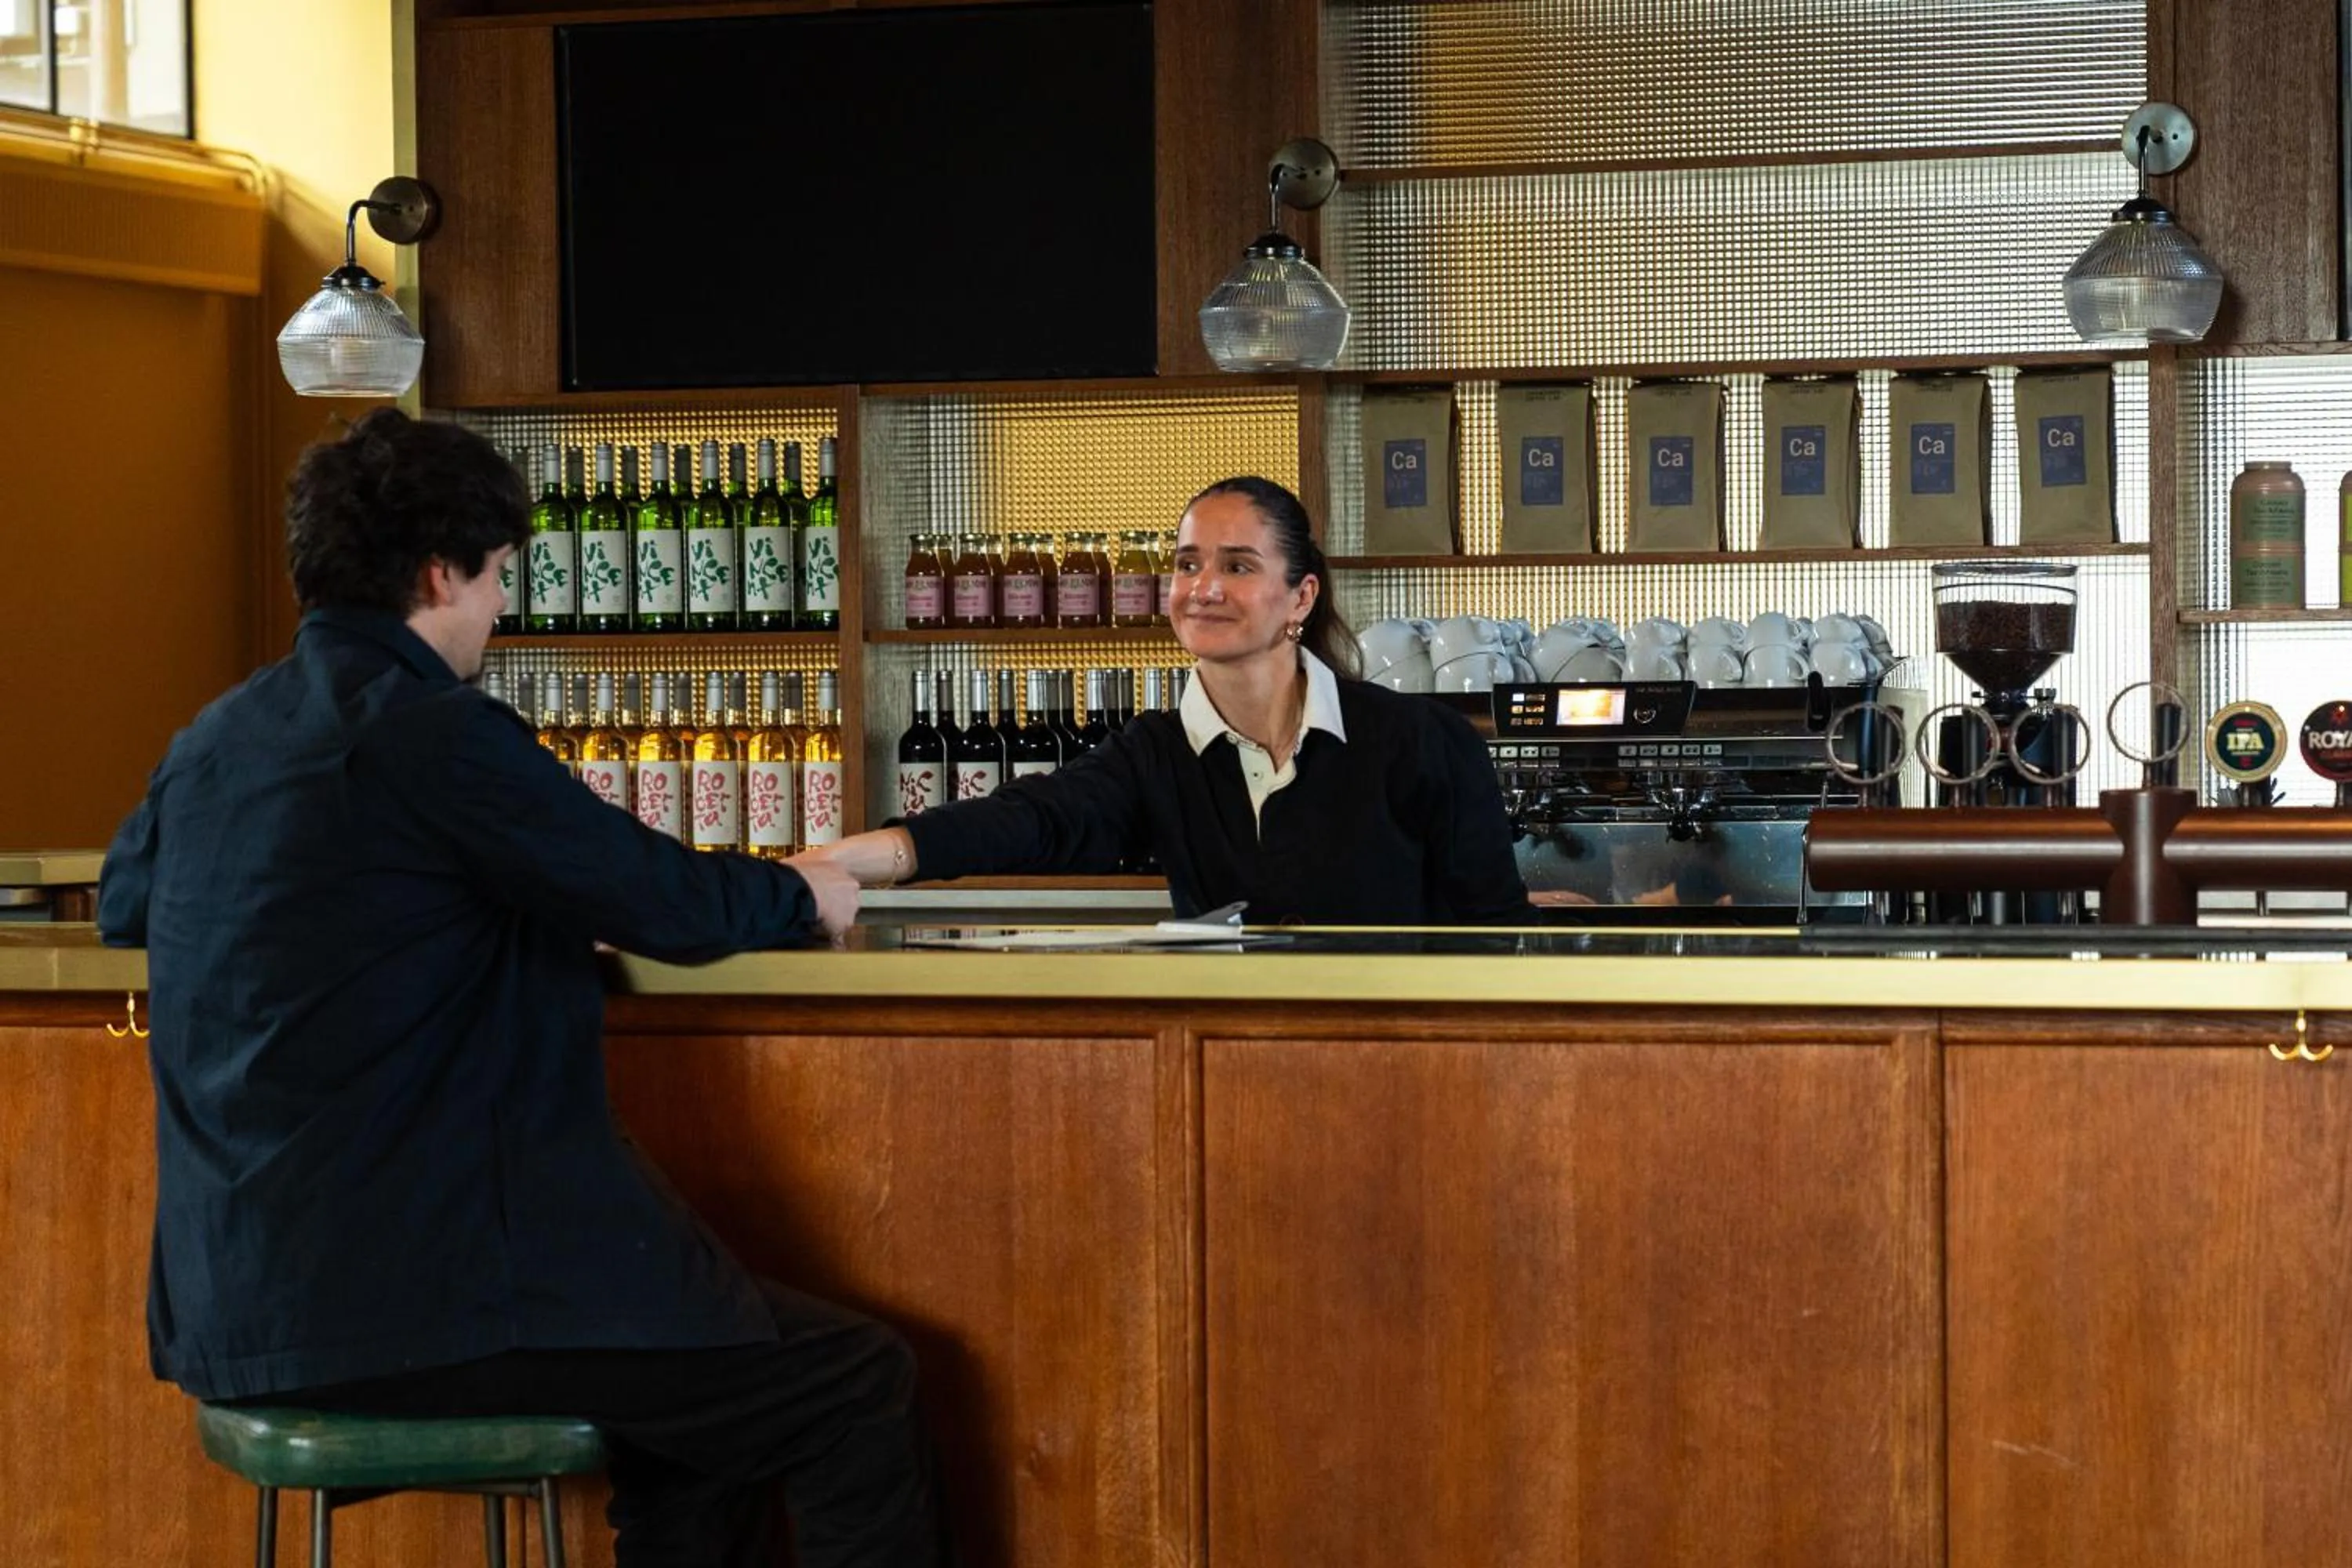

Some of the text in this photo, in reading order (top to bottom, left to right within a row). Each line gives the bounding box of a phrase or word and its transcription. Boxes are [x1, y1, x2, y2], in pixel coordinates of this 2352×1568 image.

[1790, 438, 1816, 456] Ca
[1918, 435, 1945, 455] Ca
[2048, 428, 2074, 447] Ca
[1392, 451, 1417, 470] Ca
[1528, 448, 1555, 467] Ca
[1657, 448, 1684, 466] Ca
[2227, 731, 2264, 750] IPA
